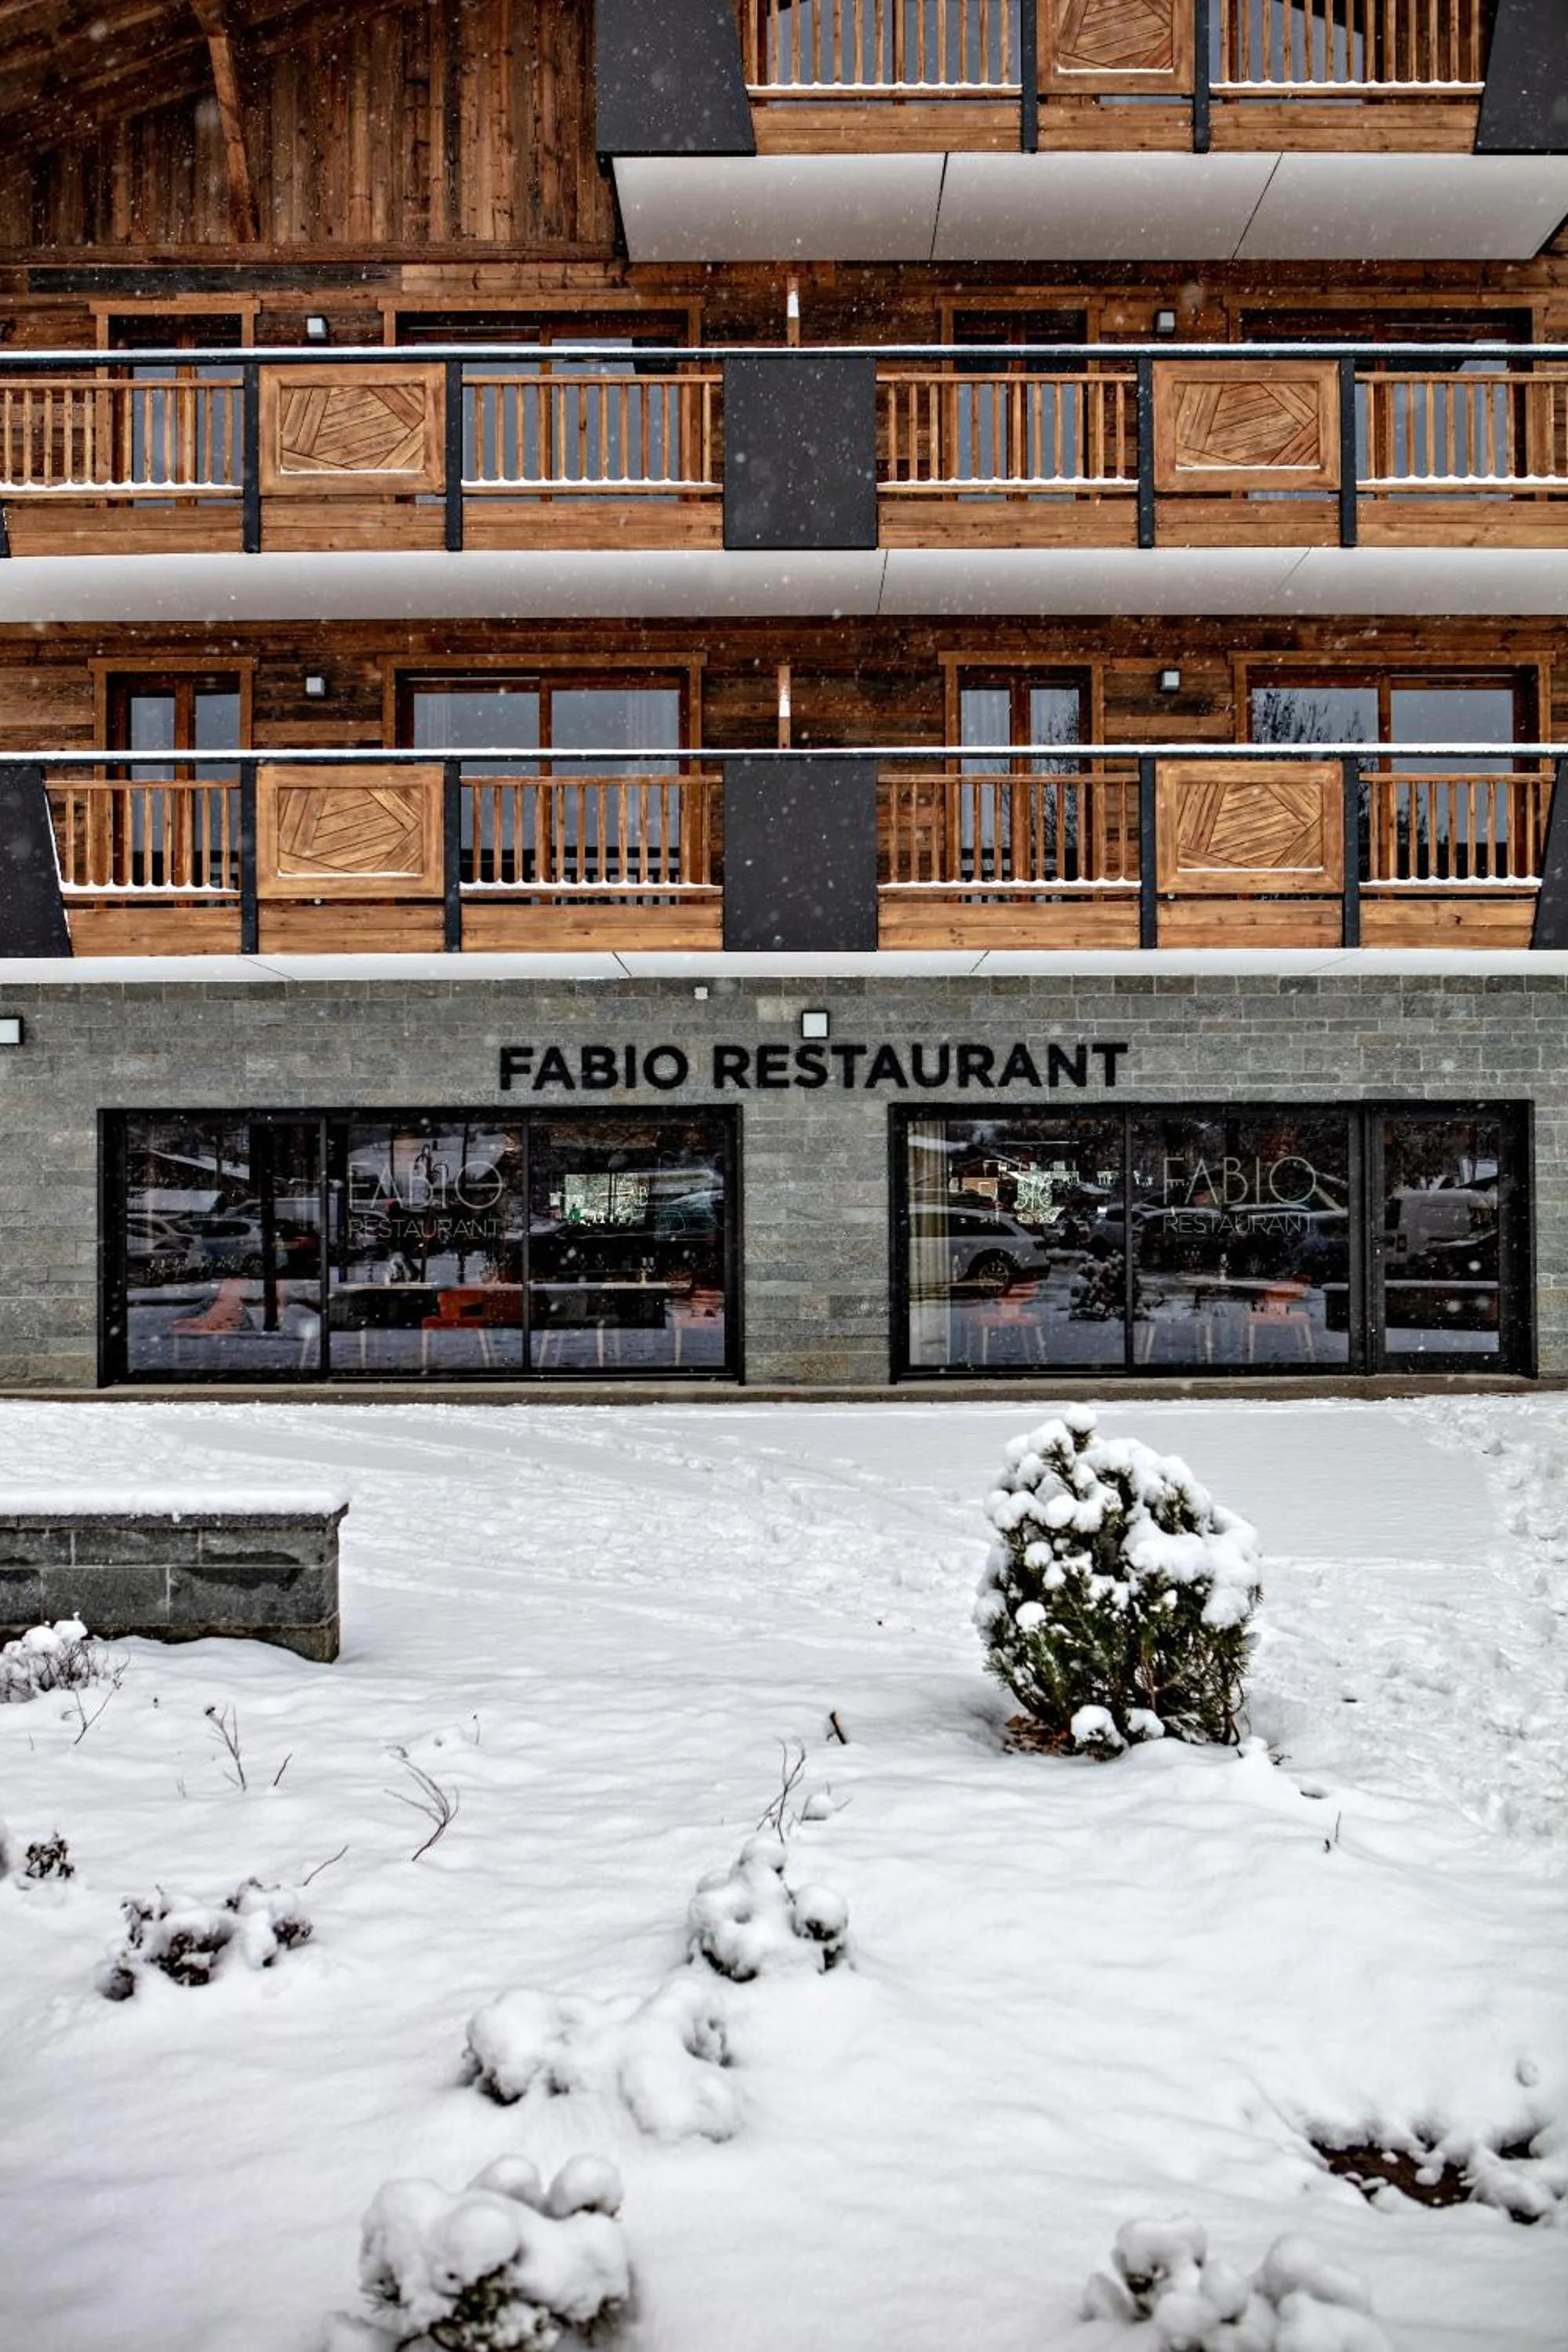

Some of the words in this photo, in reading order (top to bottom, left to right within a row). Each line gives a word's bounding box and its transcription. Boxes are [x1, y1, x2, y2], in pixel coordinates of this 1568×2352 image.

[499, 1044, 689, 1091] FABIO
[713, 1042, 1129, 1089] RESTAURANT
[348, 1160, 503, 1210] FABIO
[1163, 1156, 1316, 1205] FABIO
[348, 1218, 503, 1240] RESTAURANT
[1163, 1214, 1316, 1233] RESTAURANT
